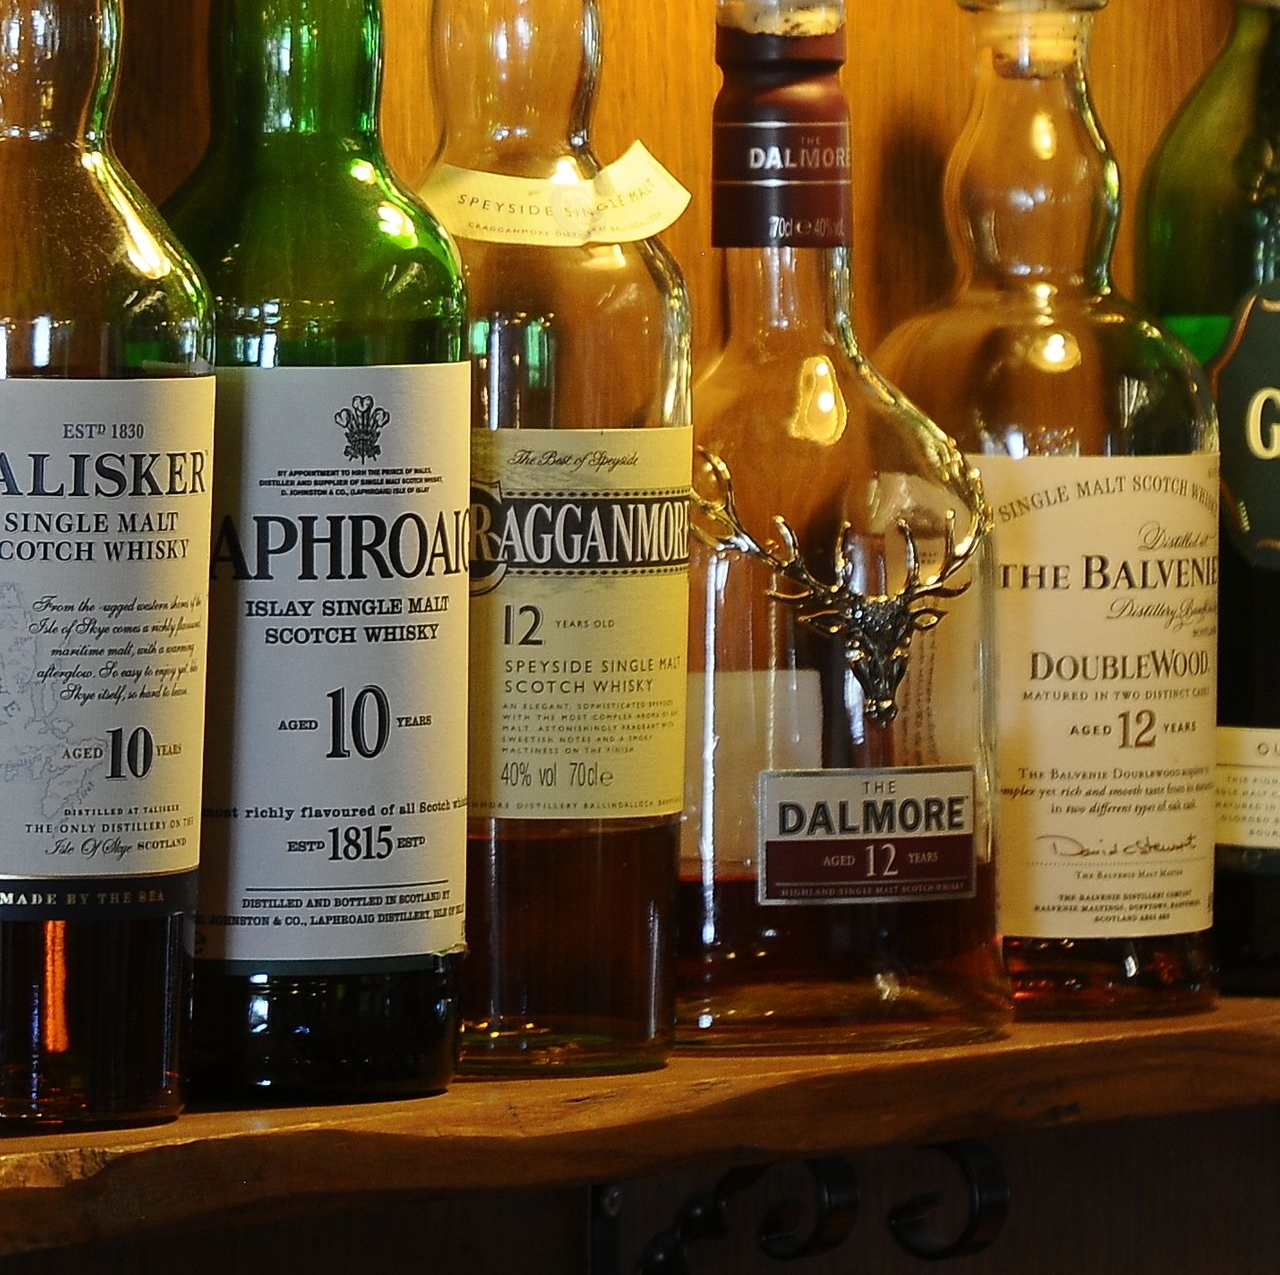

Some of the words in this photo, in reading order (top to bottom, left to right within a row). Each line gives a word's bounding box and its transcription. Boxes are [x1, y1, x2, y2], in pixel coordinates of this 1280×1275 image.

[749, 147, 851, 169] DALMORE
[458, 193, 553, 216] SPEYSIDE
[564, 196, 624, 218] SINGLE
[628, 177, 656, 203] MALT
[112, 423, 144, 439] 1830
[508, 450, 535, 465] The
[538, 451, 572, 466] Best
[589, 451, 640, 473] Speyside
[998, 485, 1069, 523] SINGLE
[1077, 476, 1126, 498] MALT
[1133, 475, 1189, 495] SCOTCH
[5, 512, 109, 533] SINGLE
[117, 511, 178, 533] MALT
[470, 501, 690, 564] RAGGANMORE
[103, 539, 189, 561] WHISKY
[211, 508, 468, 580] APHROAI
[999, 564, 1070, 590] THE
[1082, 555, 1218, 590] BALVENIE
[246, 600, 314, 617] ISLAY
[322, 598, 403, 616] SINGLE
[408, 596, 449, 614] MALT
[265, 628, 357, 645] SCOTCH
[363, 624, 440, 643] WHISKY
[504, 605, 543, 646] 12
[555, 620, 589, 628] YEARS
[593, 620, 615, 628] OLD
[505, 660, 593, 674] SPEYSIDE
[601, 658, 653, 673] SINGLE
[659, 656, 680, 670] MALT
[1030, 649, 1208, 681] DOUBLEWOOD
[505, 680, 585, 694] SCOTCH
[593, 679, 653, 693] WHISKY
[1023, 691, 1089, 701] MATURED
[1114, 690, 1140, 700] TWO
[278, 719, 318, 731] AGED
[326, 685, 390, 759] 10
[396, 716, 432, 728] YEARS
[1070, 725, 1112, 736] AGED
[1117, 709, 1157, 749] 12
[1163, 721, 1196, 733] YEARS
[62, 746, 104, 759] AGED
[106, 726, 153, 780] 10
[156, 743, 182, 757] YEARS
[501, 763, 532, 787] 40%
[539, 763, 557, 787] vol
[863, 781, 896, 794] THE
[245, 805, 295, 822] richly
[301, 805, 376, 818] flavoured
[381, 804, 396, 816] of
[399, 803, 416, 815] all
[419, 800, 451, 814] Scotch
[779, 795, 965, 836] DALMORE
[26, 824, 53, 834] THE
[60, 823, 95, 834] ONLY
[101, 820, 167, 833] DISTILLERY
[137, 837, 187, 851] SCOTLAND
[328, 825, 393, 861] 1815
[824, 856, 856, 867] AGED
[865, 843, 899, 877] 12
[909, 852, 938, 864] YEARS
[0, 891, 57, 906] MADE
[66, 891, 90, 905] BY
[97, 891, 131, 904] THE
[139, 890, 164, 902] SEA
[242, 898, 303, 909] DISTILLED
[306, 898, 331, 908] AND
[334, 896, 383, 908] BOTTLED
[399, 893, 440, 905] SCOTLAND
[781, 888, 835, 897] HIGHLAND
[310, 914, 375, 925] LAPHROAIG
